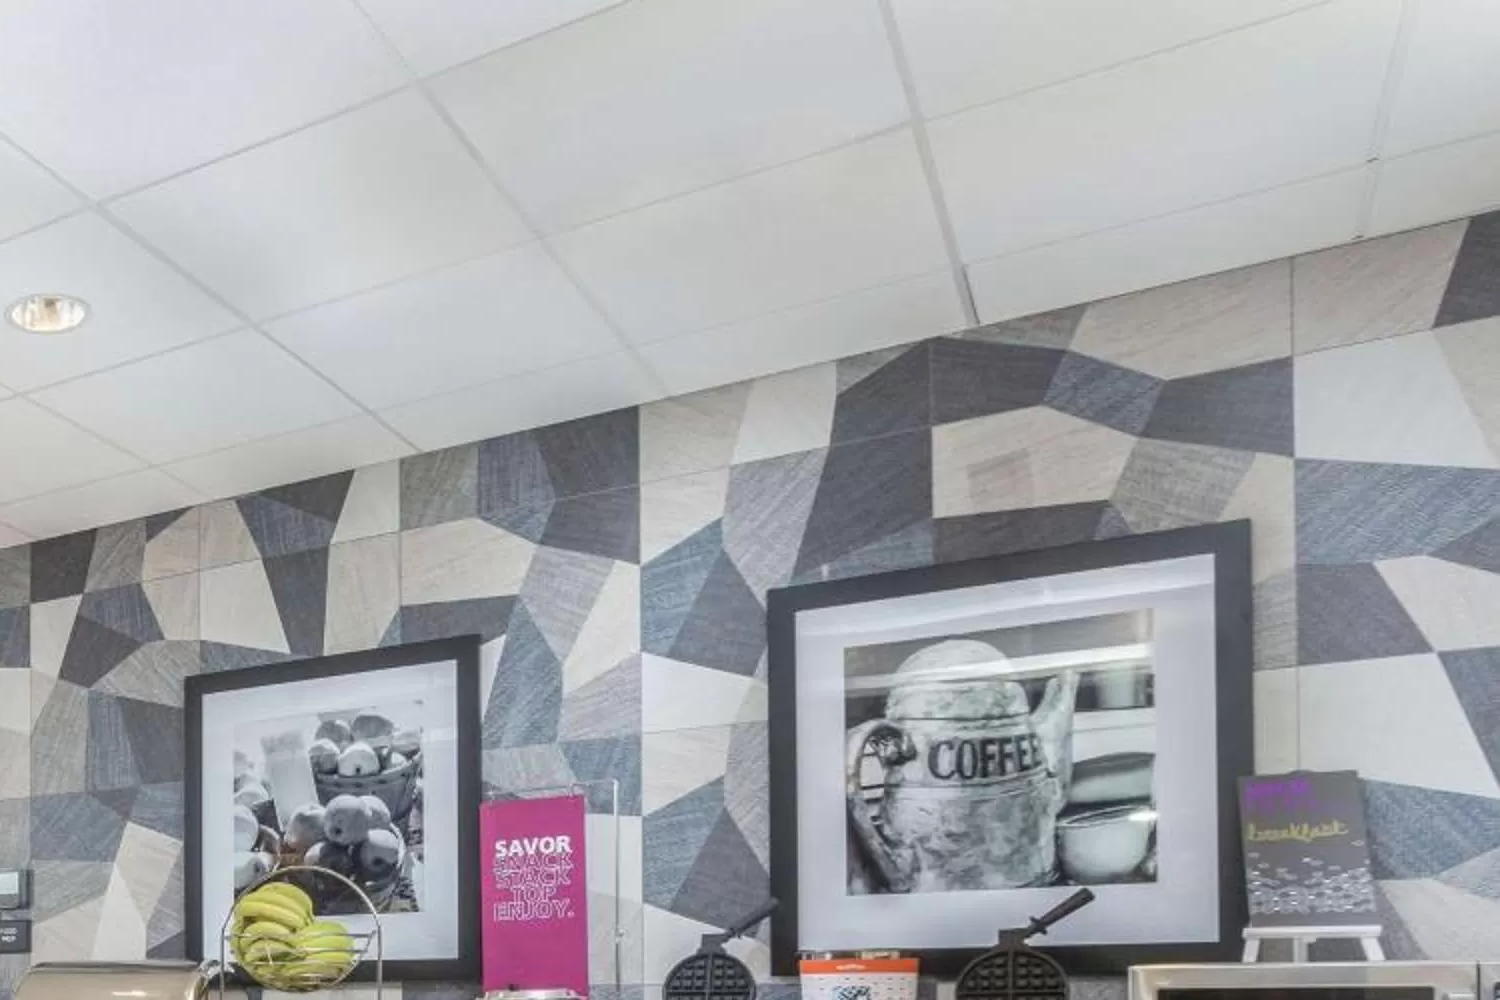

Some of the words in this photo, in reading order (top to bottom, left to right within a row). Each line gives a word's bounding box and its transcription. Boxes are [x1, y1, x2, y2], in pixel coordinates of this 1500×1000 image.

[927, 733, 1043, 780] COFFEE
[495, 835, 573, 857] SAVOR
[510, 883, 556, 902] TOP
[493, 898, 576, 922] ENJOY.
